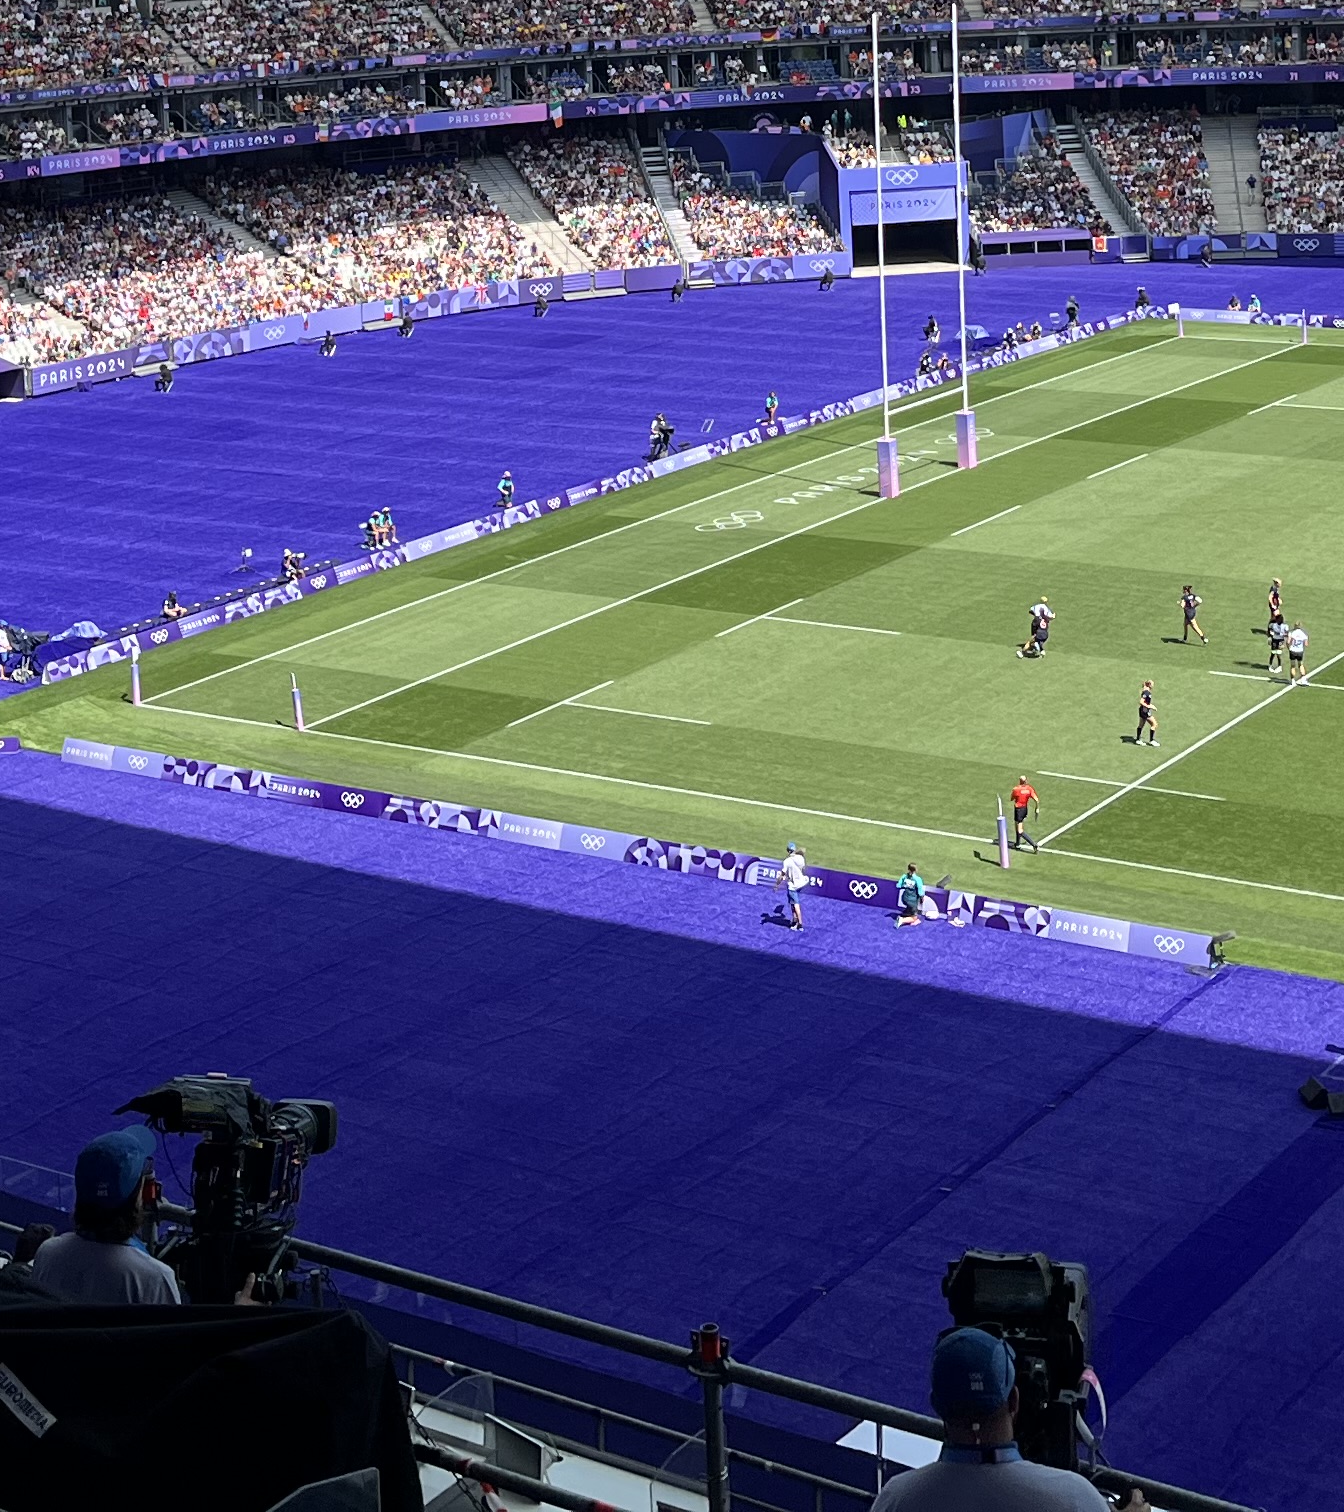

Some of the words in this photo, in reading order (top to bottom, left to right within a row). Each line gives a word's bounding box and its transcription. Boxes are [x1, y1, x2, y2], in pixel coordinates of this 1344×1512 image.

[1231, 70, 1262, 80] 2024
[1022, 78, 1052, 87] 2024
[755, 91, 784, 101] 2024
[484, 111, 511, 122] 2024
[249, 135, 275, 147] 2024
[84, 155, 113, 167] 2024
[40, 365, 82, 386] PARIS
[87, 357, 125, 378] 2024
[89, 750, 109, 762] 2024
[298, 787, 320, 798] 2024
[532, 827, 556, 840] 2024
[1056, 922, 1088, 935] PARIS
[1092, 926, 1123, 940] 2024
